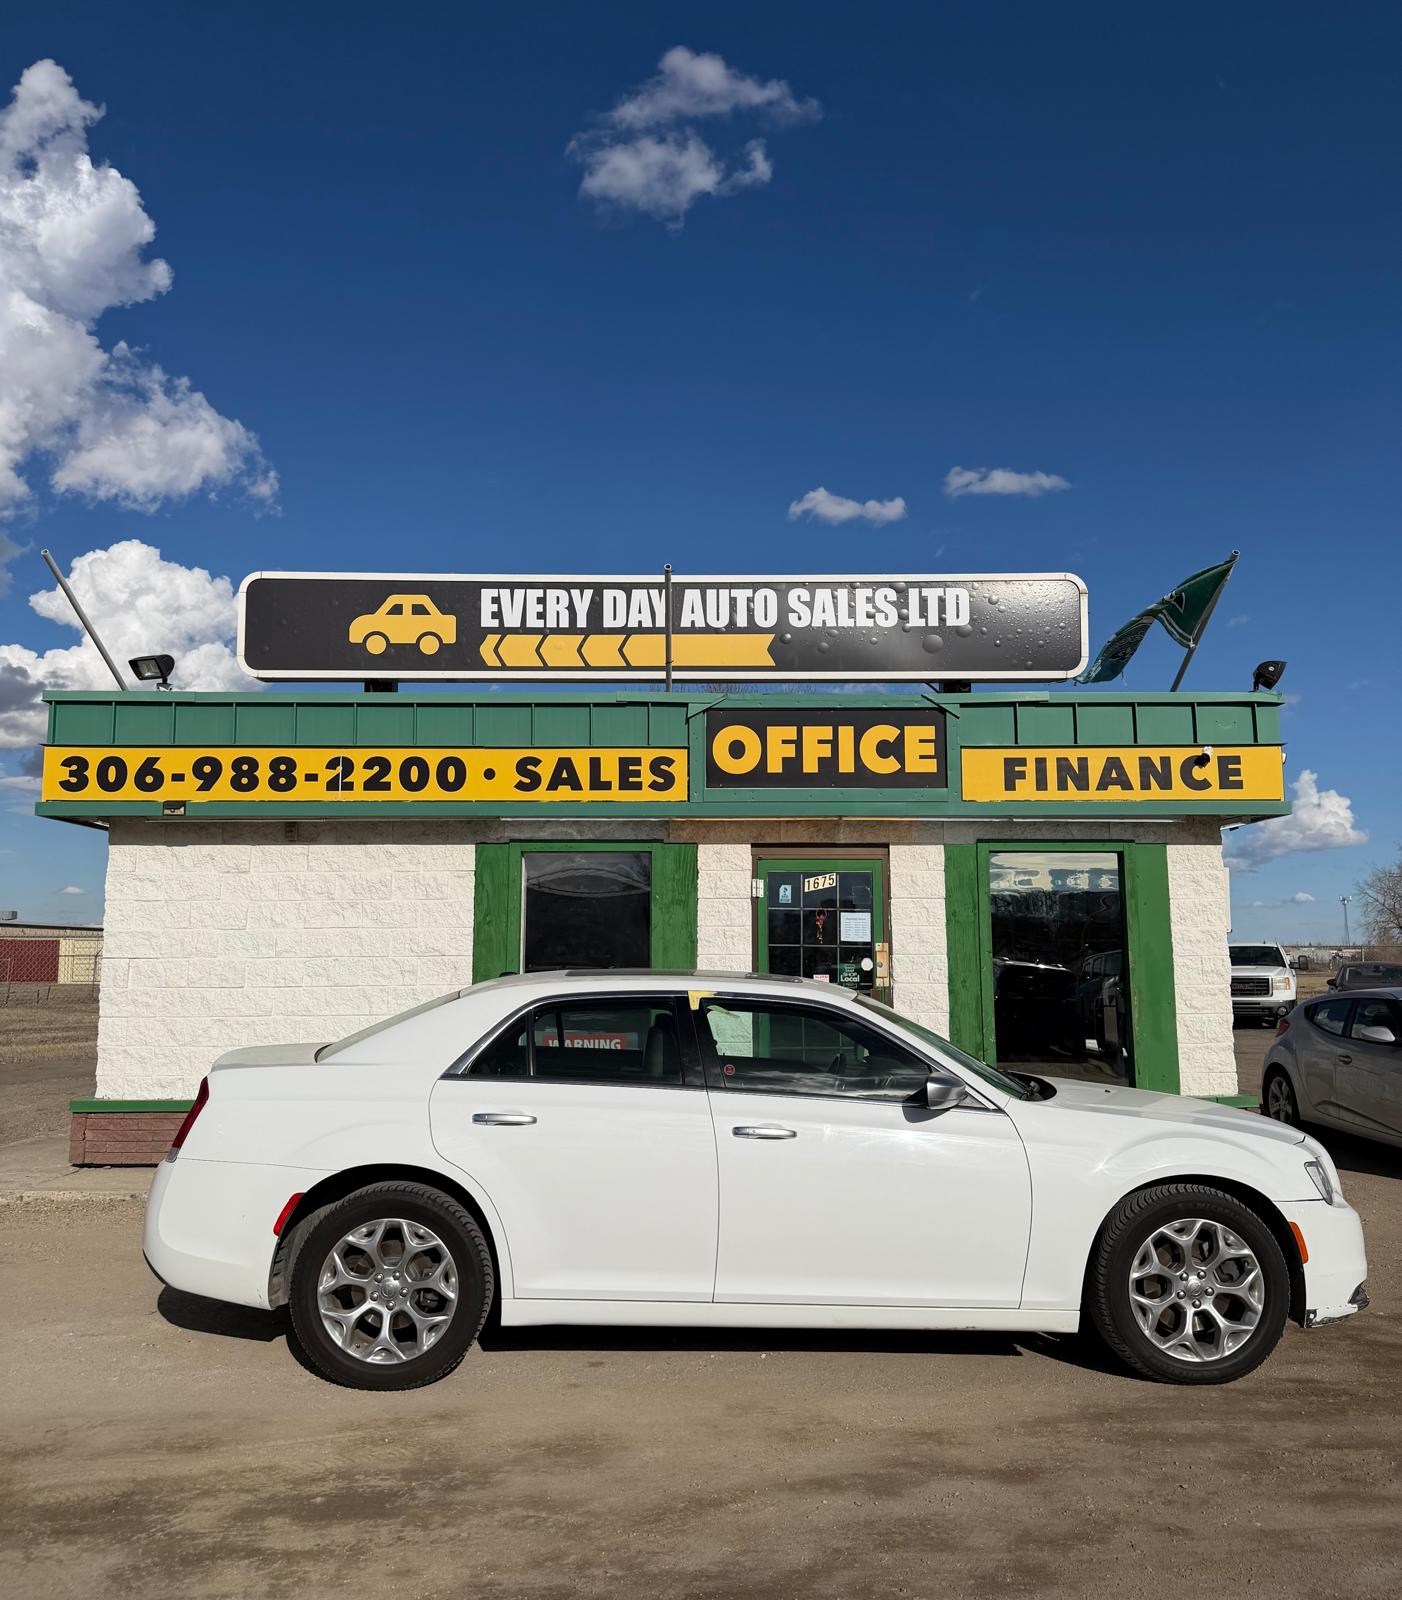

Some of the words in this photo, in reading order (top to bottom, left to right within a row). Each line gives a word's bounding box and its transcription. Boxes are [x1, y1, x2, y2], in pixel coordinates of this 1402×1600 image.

[480, 588, 594, 628] EVERY
[603, 588, 667, 628] DAY
[680, 588, 778, 628] AUTO
[787, 587, 899, 628] SALES
[909, 588, 970, 628] LTD
[712, 724, 938, 775] OFFICE
[58, 755, 467, 793] 306-988-2200
[513, 755, 676, 793] SALES
[1003, 755, 1244, 792] FINANCE
[806, 873, 835, 891] 1675
